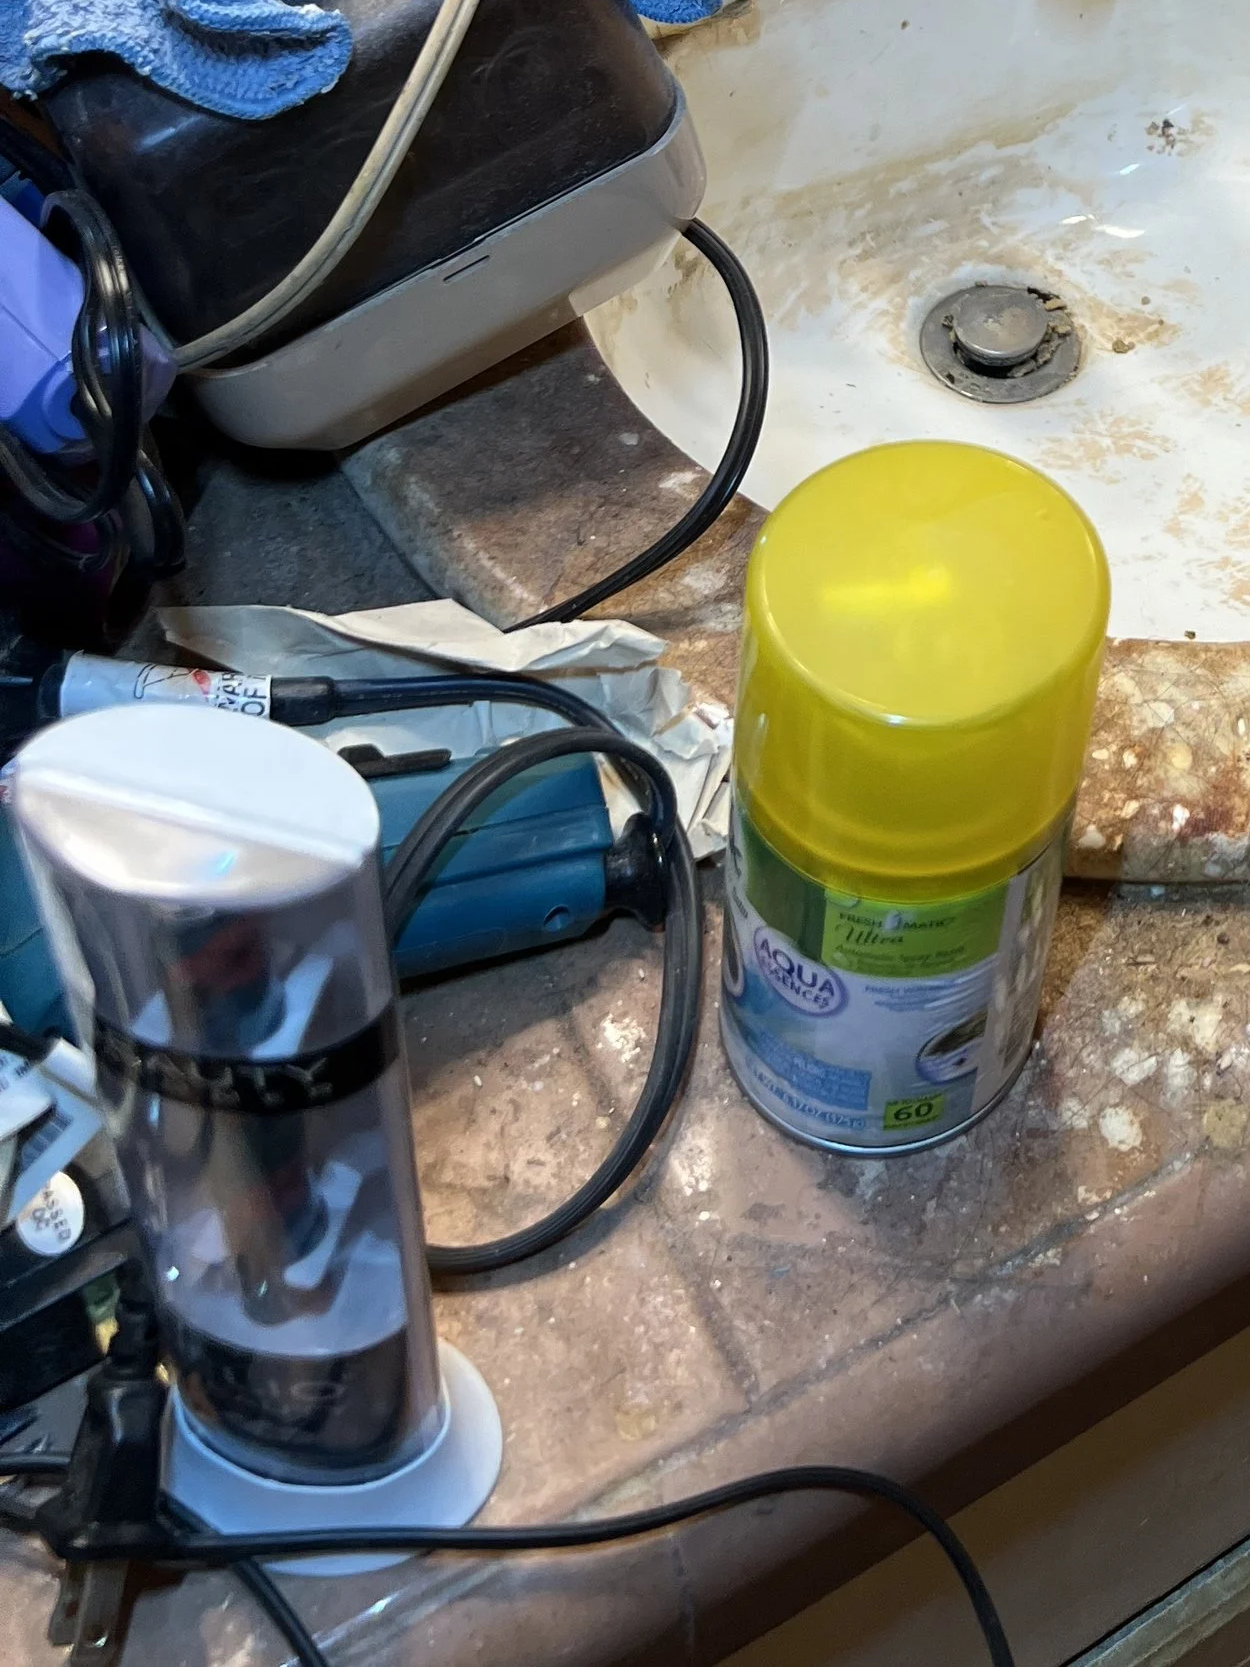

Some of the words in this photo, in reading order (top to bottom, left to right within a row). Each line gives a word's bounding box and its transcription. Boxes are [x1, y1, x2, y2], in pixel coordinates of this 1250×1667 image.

[834, 922, 904, 946] Ultra
[760, 937, 835, 998] AQUA
[893, 1101, 936, 1122] 60
